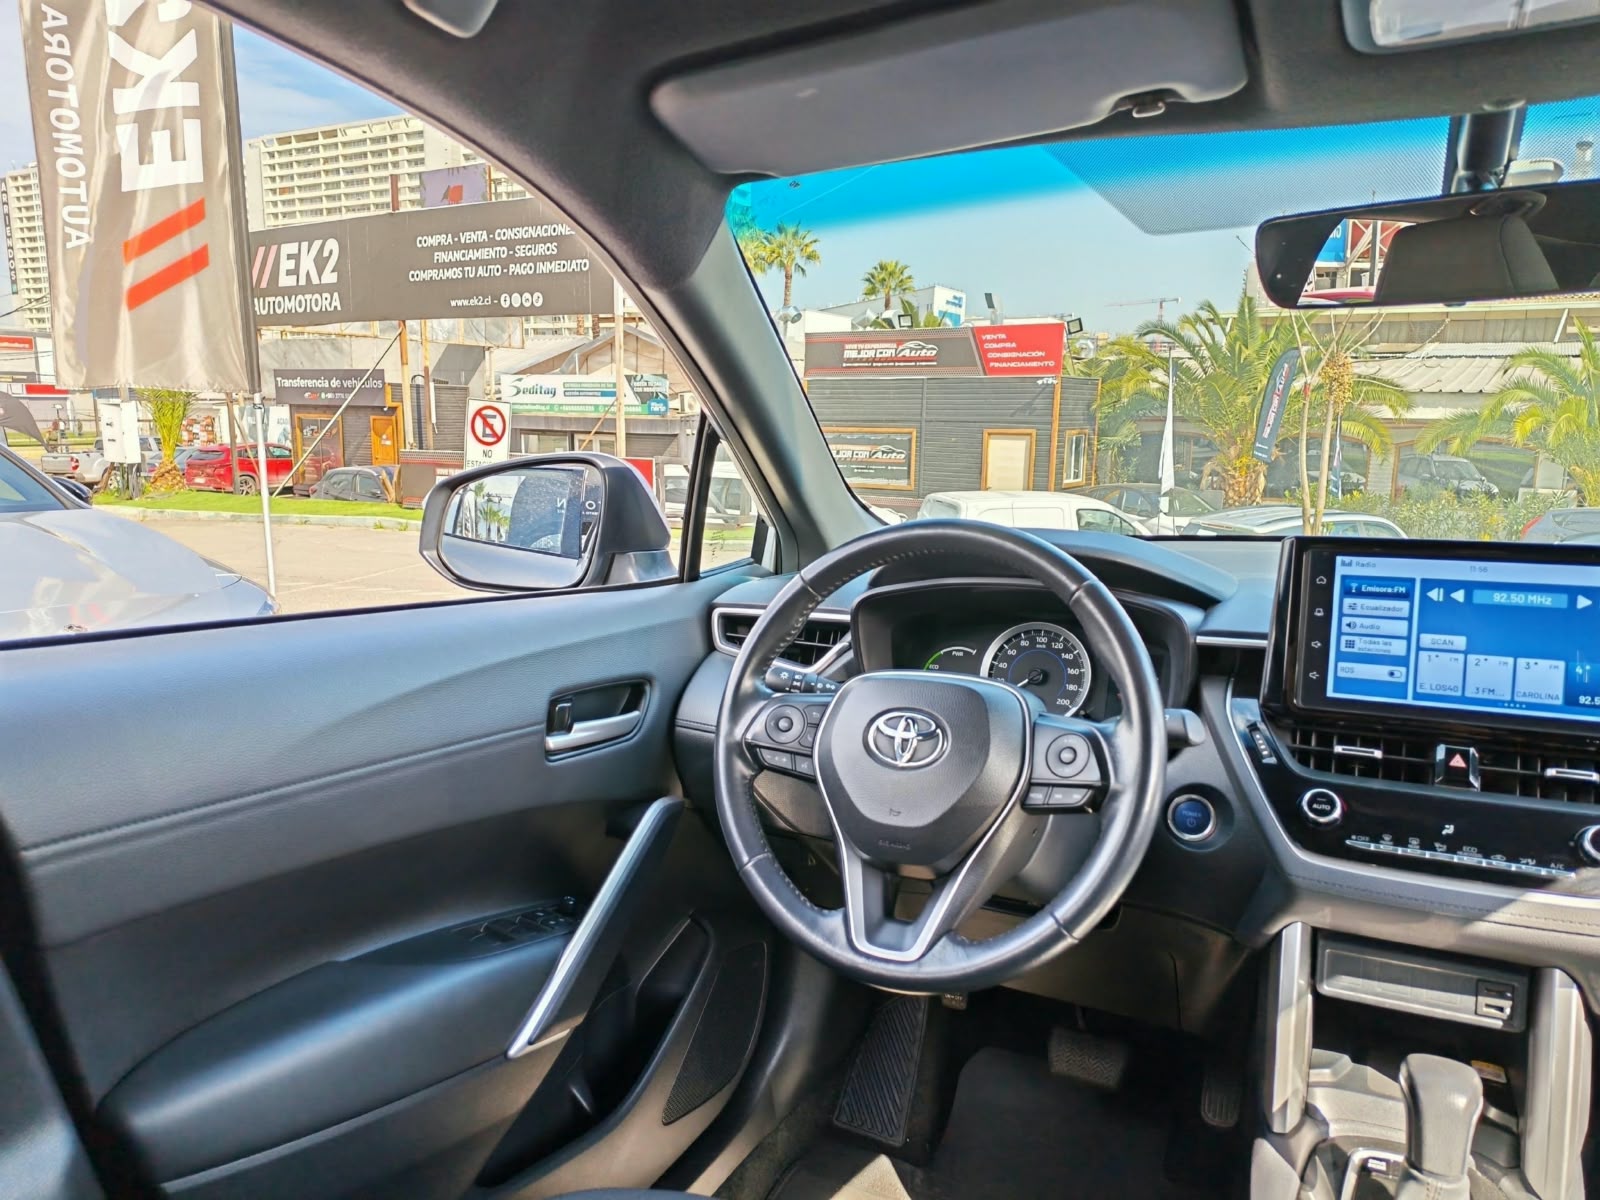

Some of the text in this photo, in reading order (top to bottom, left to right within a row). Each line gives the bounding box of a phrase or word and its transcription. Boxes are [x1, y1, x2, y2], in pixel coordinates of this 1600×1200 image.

[0, 181, 17, 282] ARRIENDOS
[417, 224, 576, 248] COMPRA VENTA CONSIGNACIONE
[434, 242, 558, 263] FINANCIAMIENTO SEGUROS
[278, 237, 340, 288] EK2
[409, 259, 590, 281] COMPRAMOS TU AUTO PAGO INMEDIATO
[450, 295, 492, 307] www.ek2.cl
[990, 360, 1056, 368] FINANCIAMIENTO
[276, 377, 329, 388] Transferencia
[330, 377, 341, 388] de
[482, 449, 493, 458] NO
[1493, 592, 1553, 605] 92.50 MHz
[1430, 638, 1454, 646] SCAN
[1067, 667, 1080, 675] 160
[1066, 683, 1078, 691] 180
[1516, 691, 1560, 701] CAROLINA
[1056, 698, 1071, 706] 200
[1312, 803, 1332, 811] AUTO
[1462, 845, 1478, 854] ECO
[1550, 862, 1565, 870] A/C
